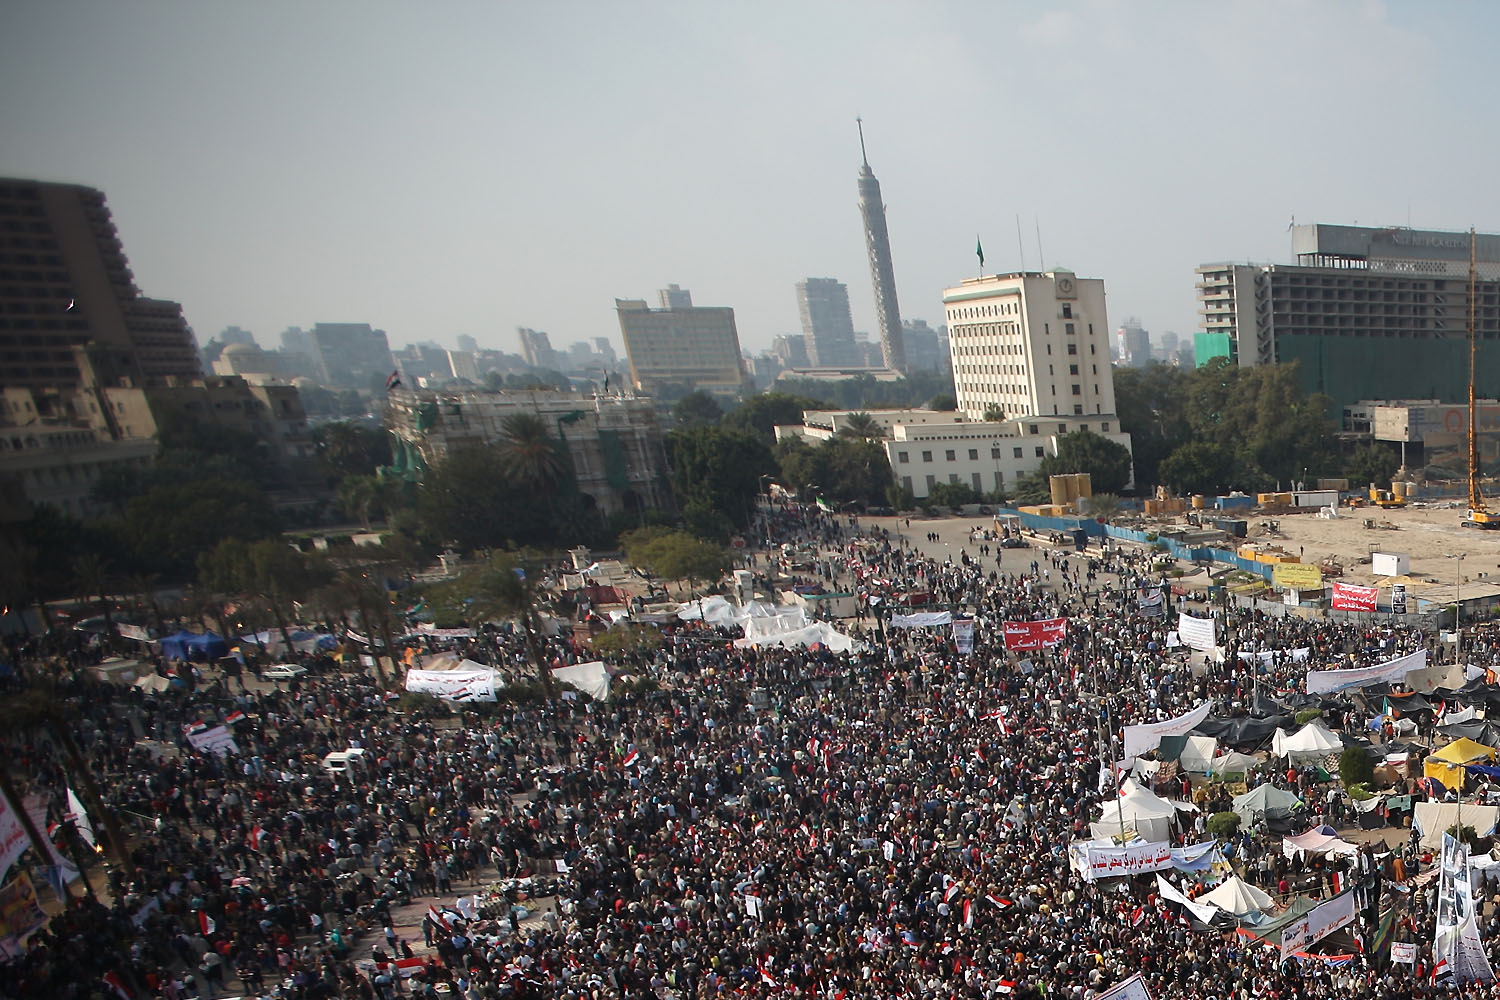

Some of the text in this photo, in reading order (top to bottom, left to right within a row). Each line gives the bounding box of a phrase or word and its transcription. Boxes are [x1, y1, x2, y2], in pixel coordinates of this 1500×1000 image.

[1005, 622, 1064, 636] يسقط يسقط
[1011, 638, 1040, 649] العسكر
